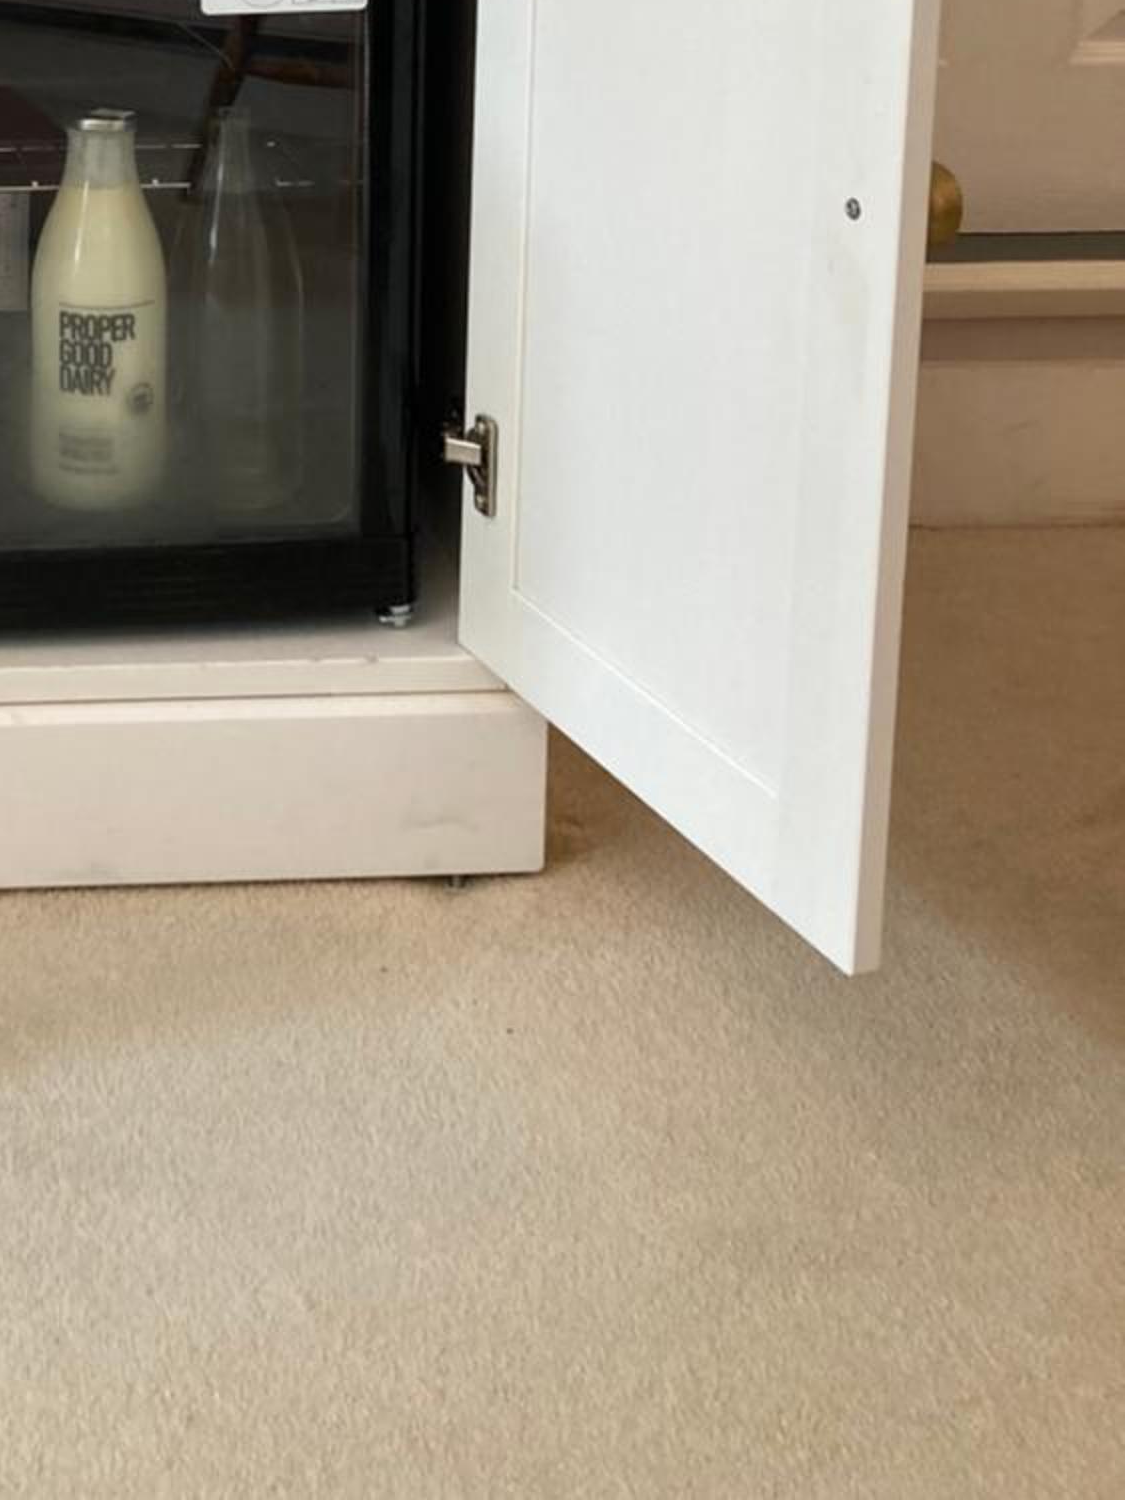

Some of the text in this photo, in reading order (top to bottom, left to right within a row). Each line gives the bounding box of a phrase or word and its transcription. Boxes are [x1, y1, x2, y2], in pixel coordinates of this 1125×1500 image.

[59, 311, 136, 343] PROPER
[59, 338, 114, 370] GOOD
[59, 365, 116, 397] DAIRY
